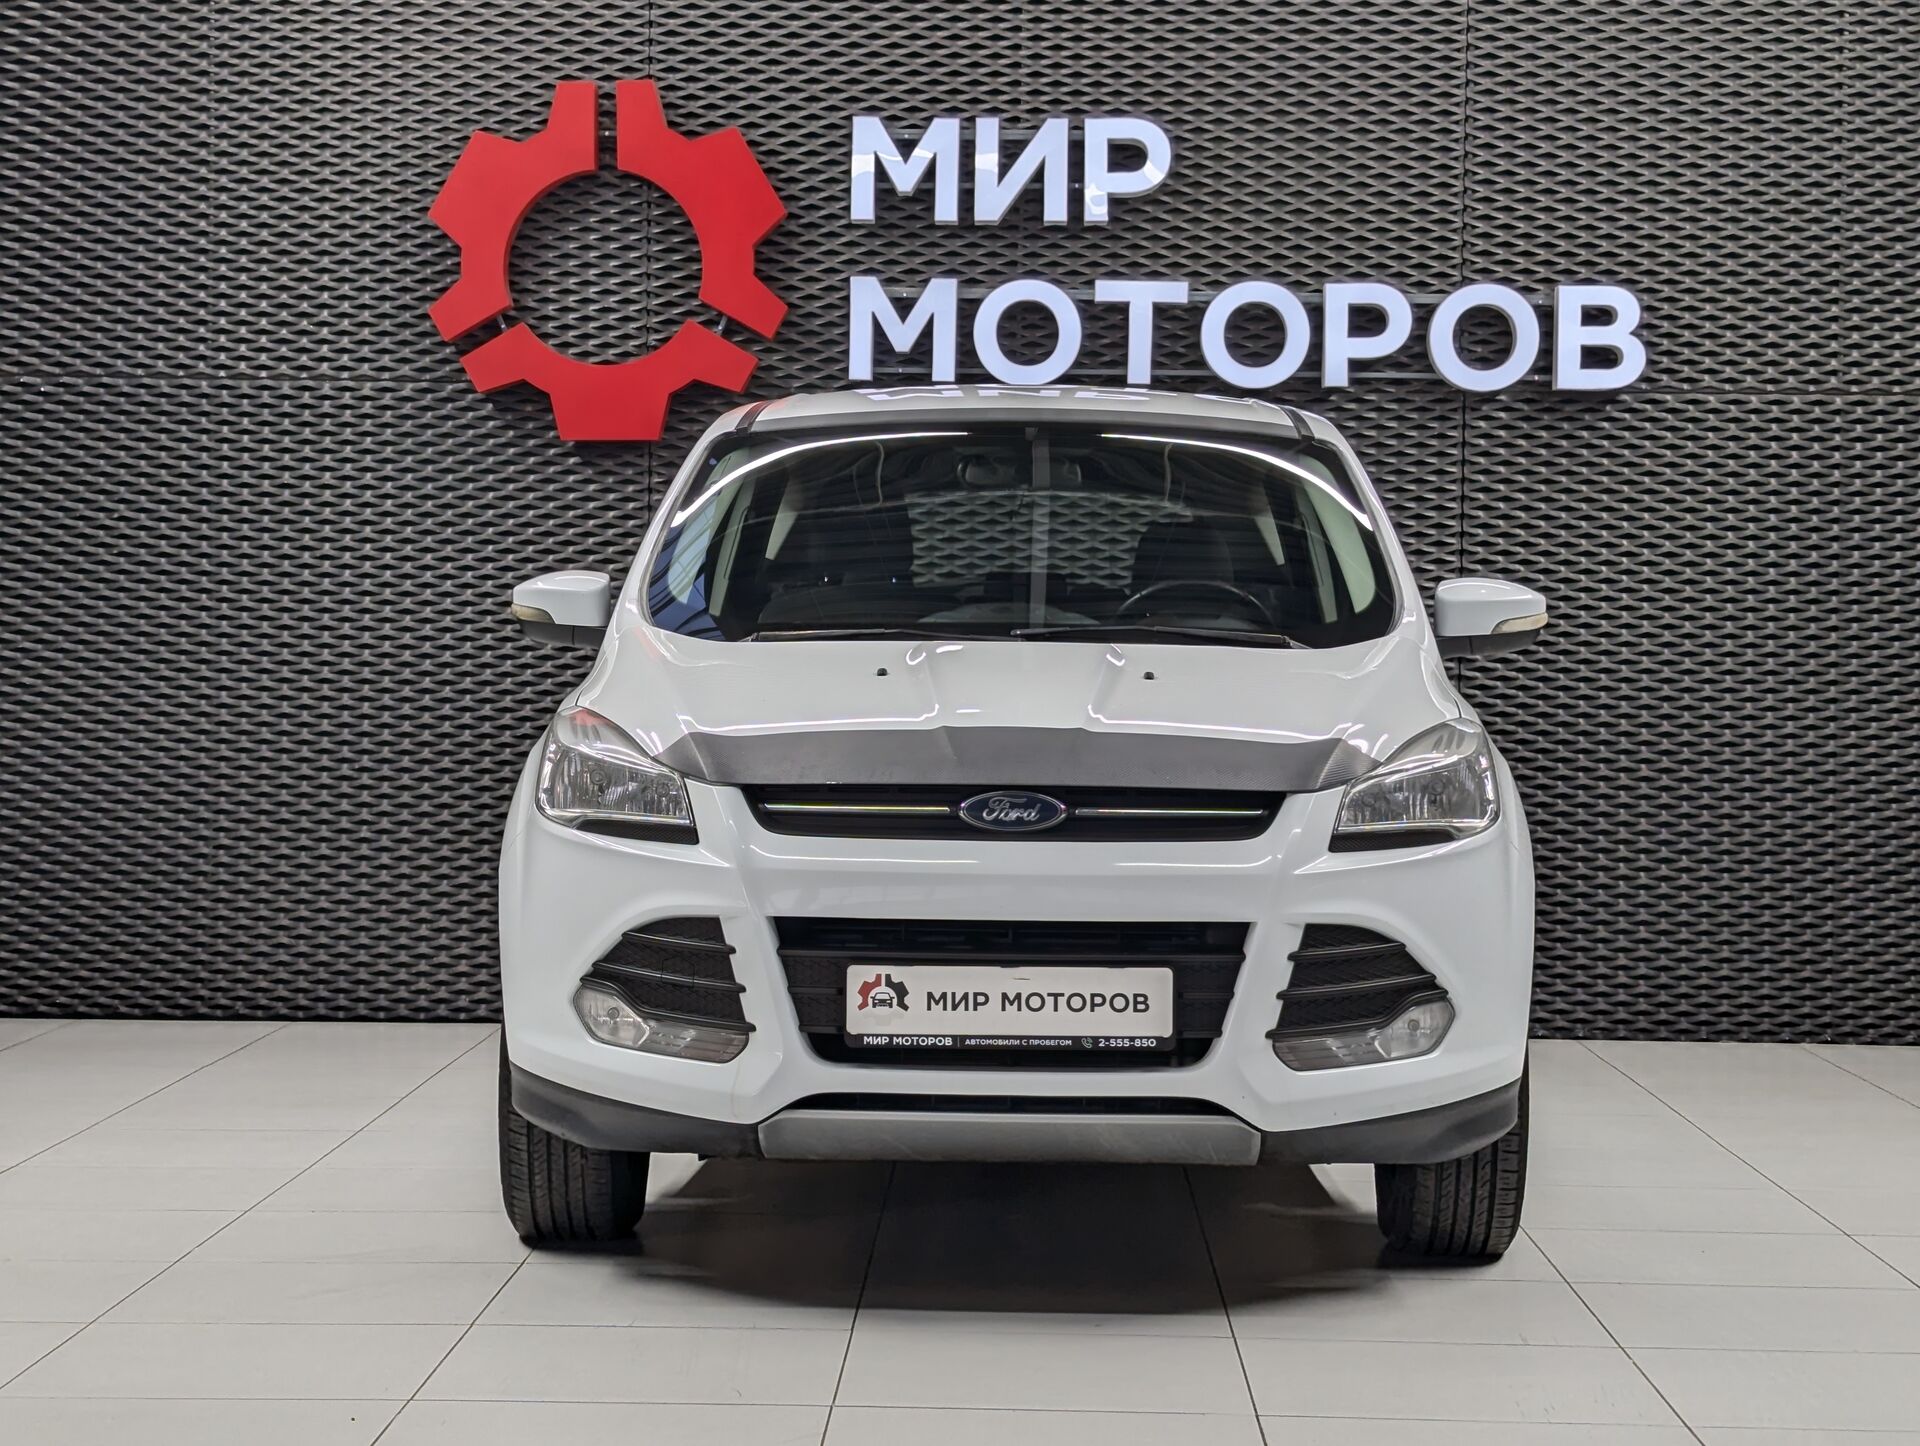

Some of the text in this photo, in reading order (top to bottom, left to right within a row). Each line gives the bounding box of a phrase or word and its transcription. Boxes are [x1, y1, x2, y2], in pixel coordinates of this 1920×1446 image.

[850, 115, 1172, 226] МИР
[847, 276, 1647, 391] МОТОРОВ
[982, 796, 1042, 821] Ford
[926, 991, 1151, 1013] МИР МОТОРОВ
[863, 1036, 953, 1046] МИР МОТОРОВ
[964, 1038, 1020, 1046] АВТОМОБИЛИ
[1029, 1039, 1072, 1047] ПРОБЕГОМ
[1098, 1038, 1156, 1047] 2-555-850
